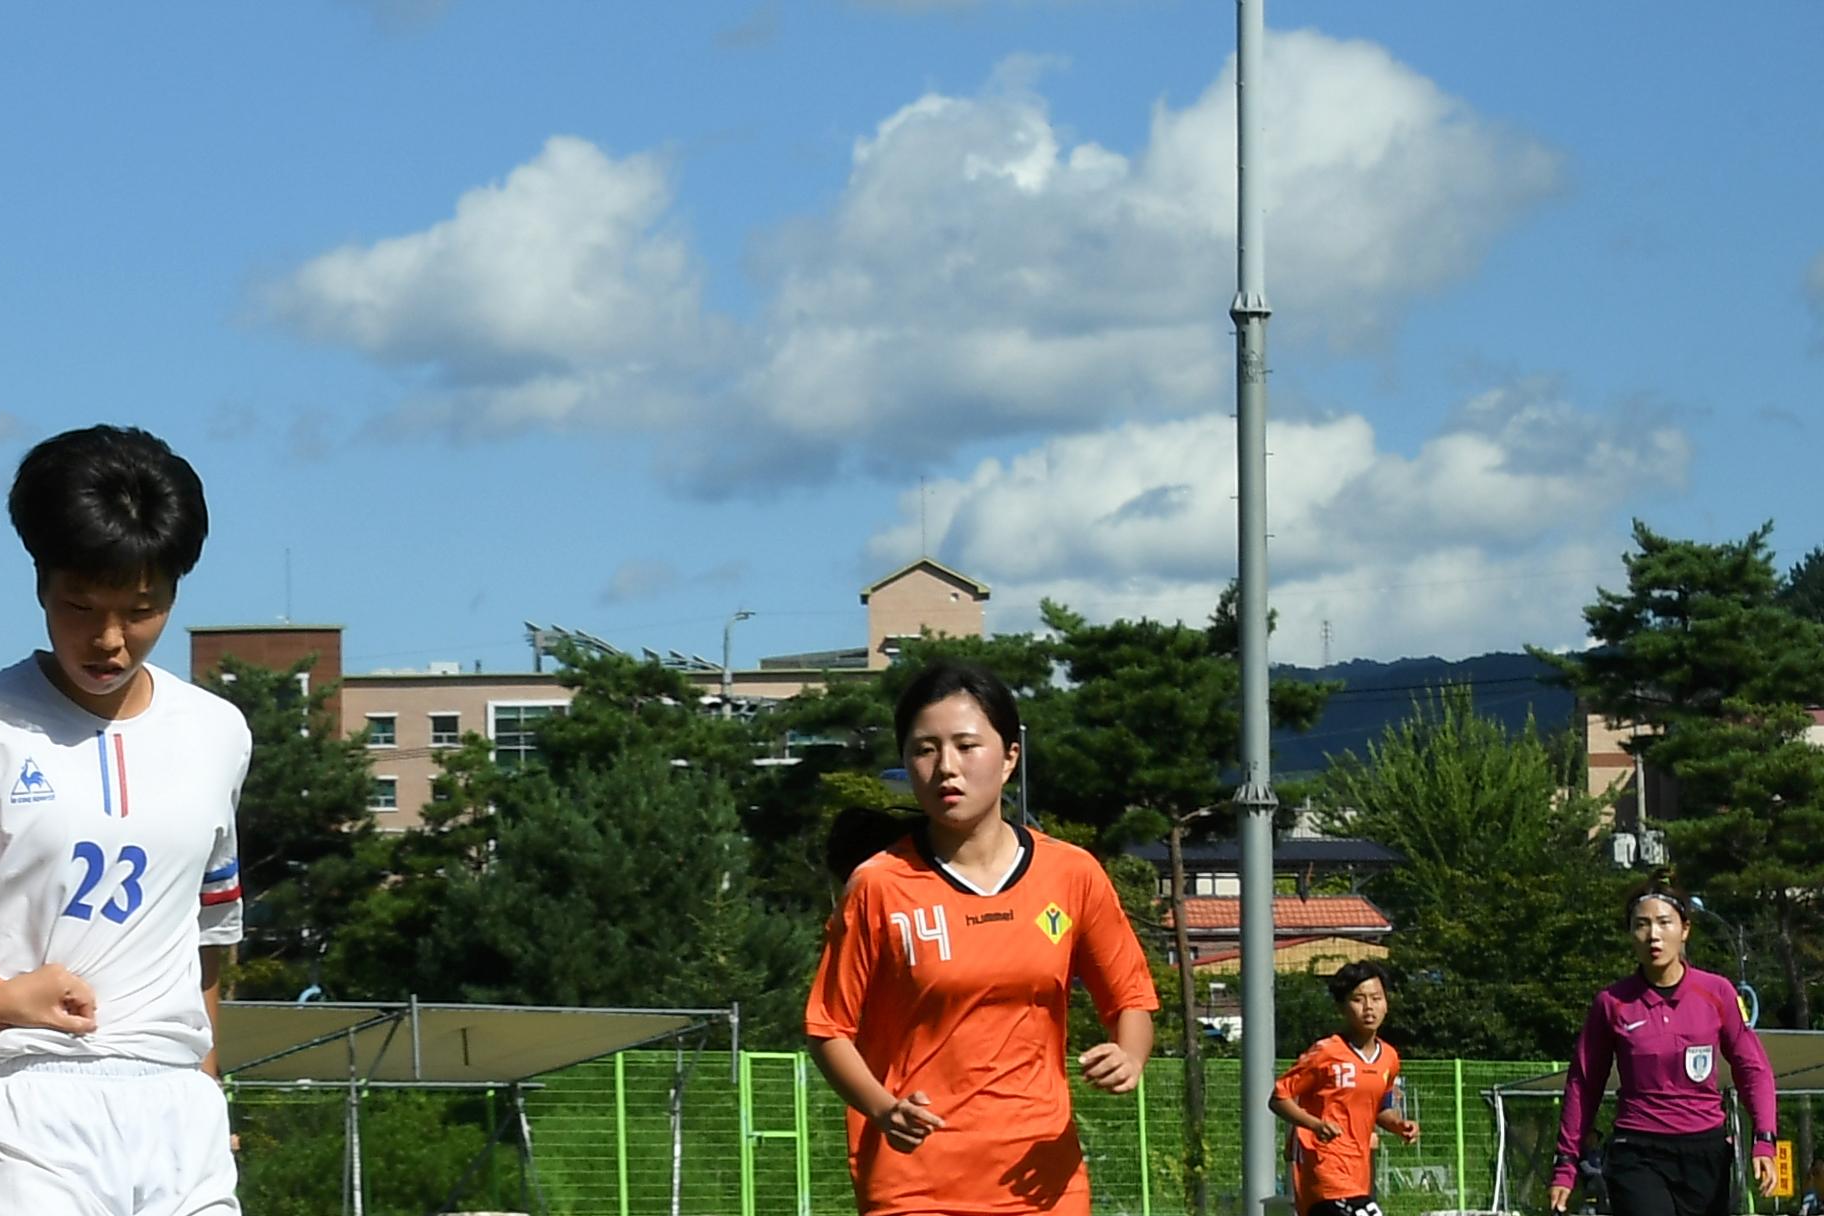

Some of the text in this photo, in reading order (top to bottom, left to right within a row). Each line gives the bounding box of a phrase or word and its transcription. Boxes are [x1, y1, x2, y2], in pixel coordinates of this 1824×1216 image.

[61, 841, 148, 925] 23
[890, 903, 951, 967] 14
[965, 909, 1014, 927] hummel
[1332, 1062, 1357, 1088] 12
